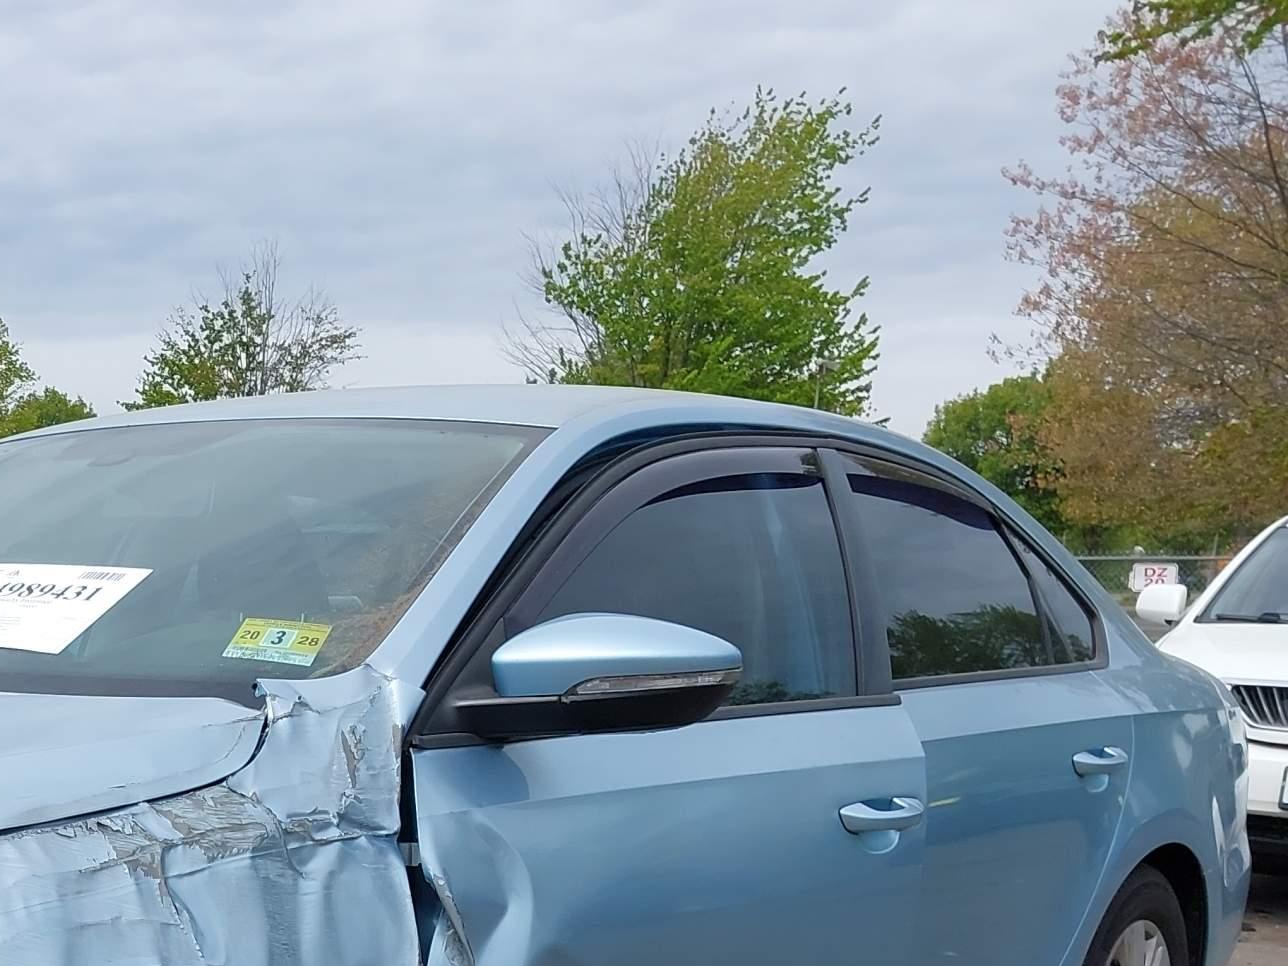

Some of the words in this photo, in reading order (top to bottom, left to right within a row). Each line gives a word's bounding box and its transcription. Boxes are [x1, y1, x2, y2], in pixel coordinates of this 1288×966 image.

[1144, 567, 1168, 578] DZ
[239, 630, 261, 641] 20
[270, 630, 287, 645] 3
[296, 635, 320, 647] 28
